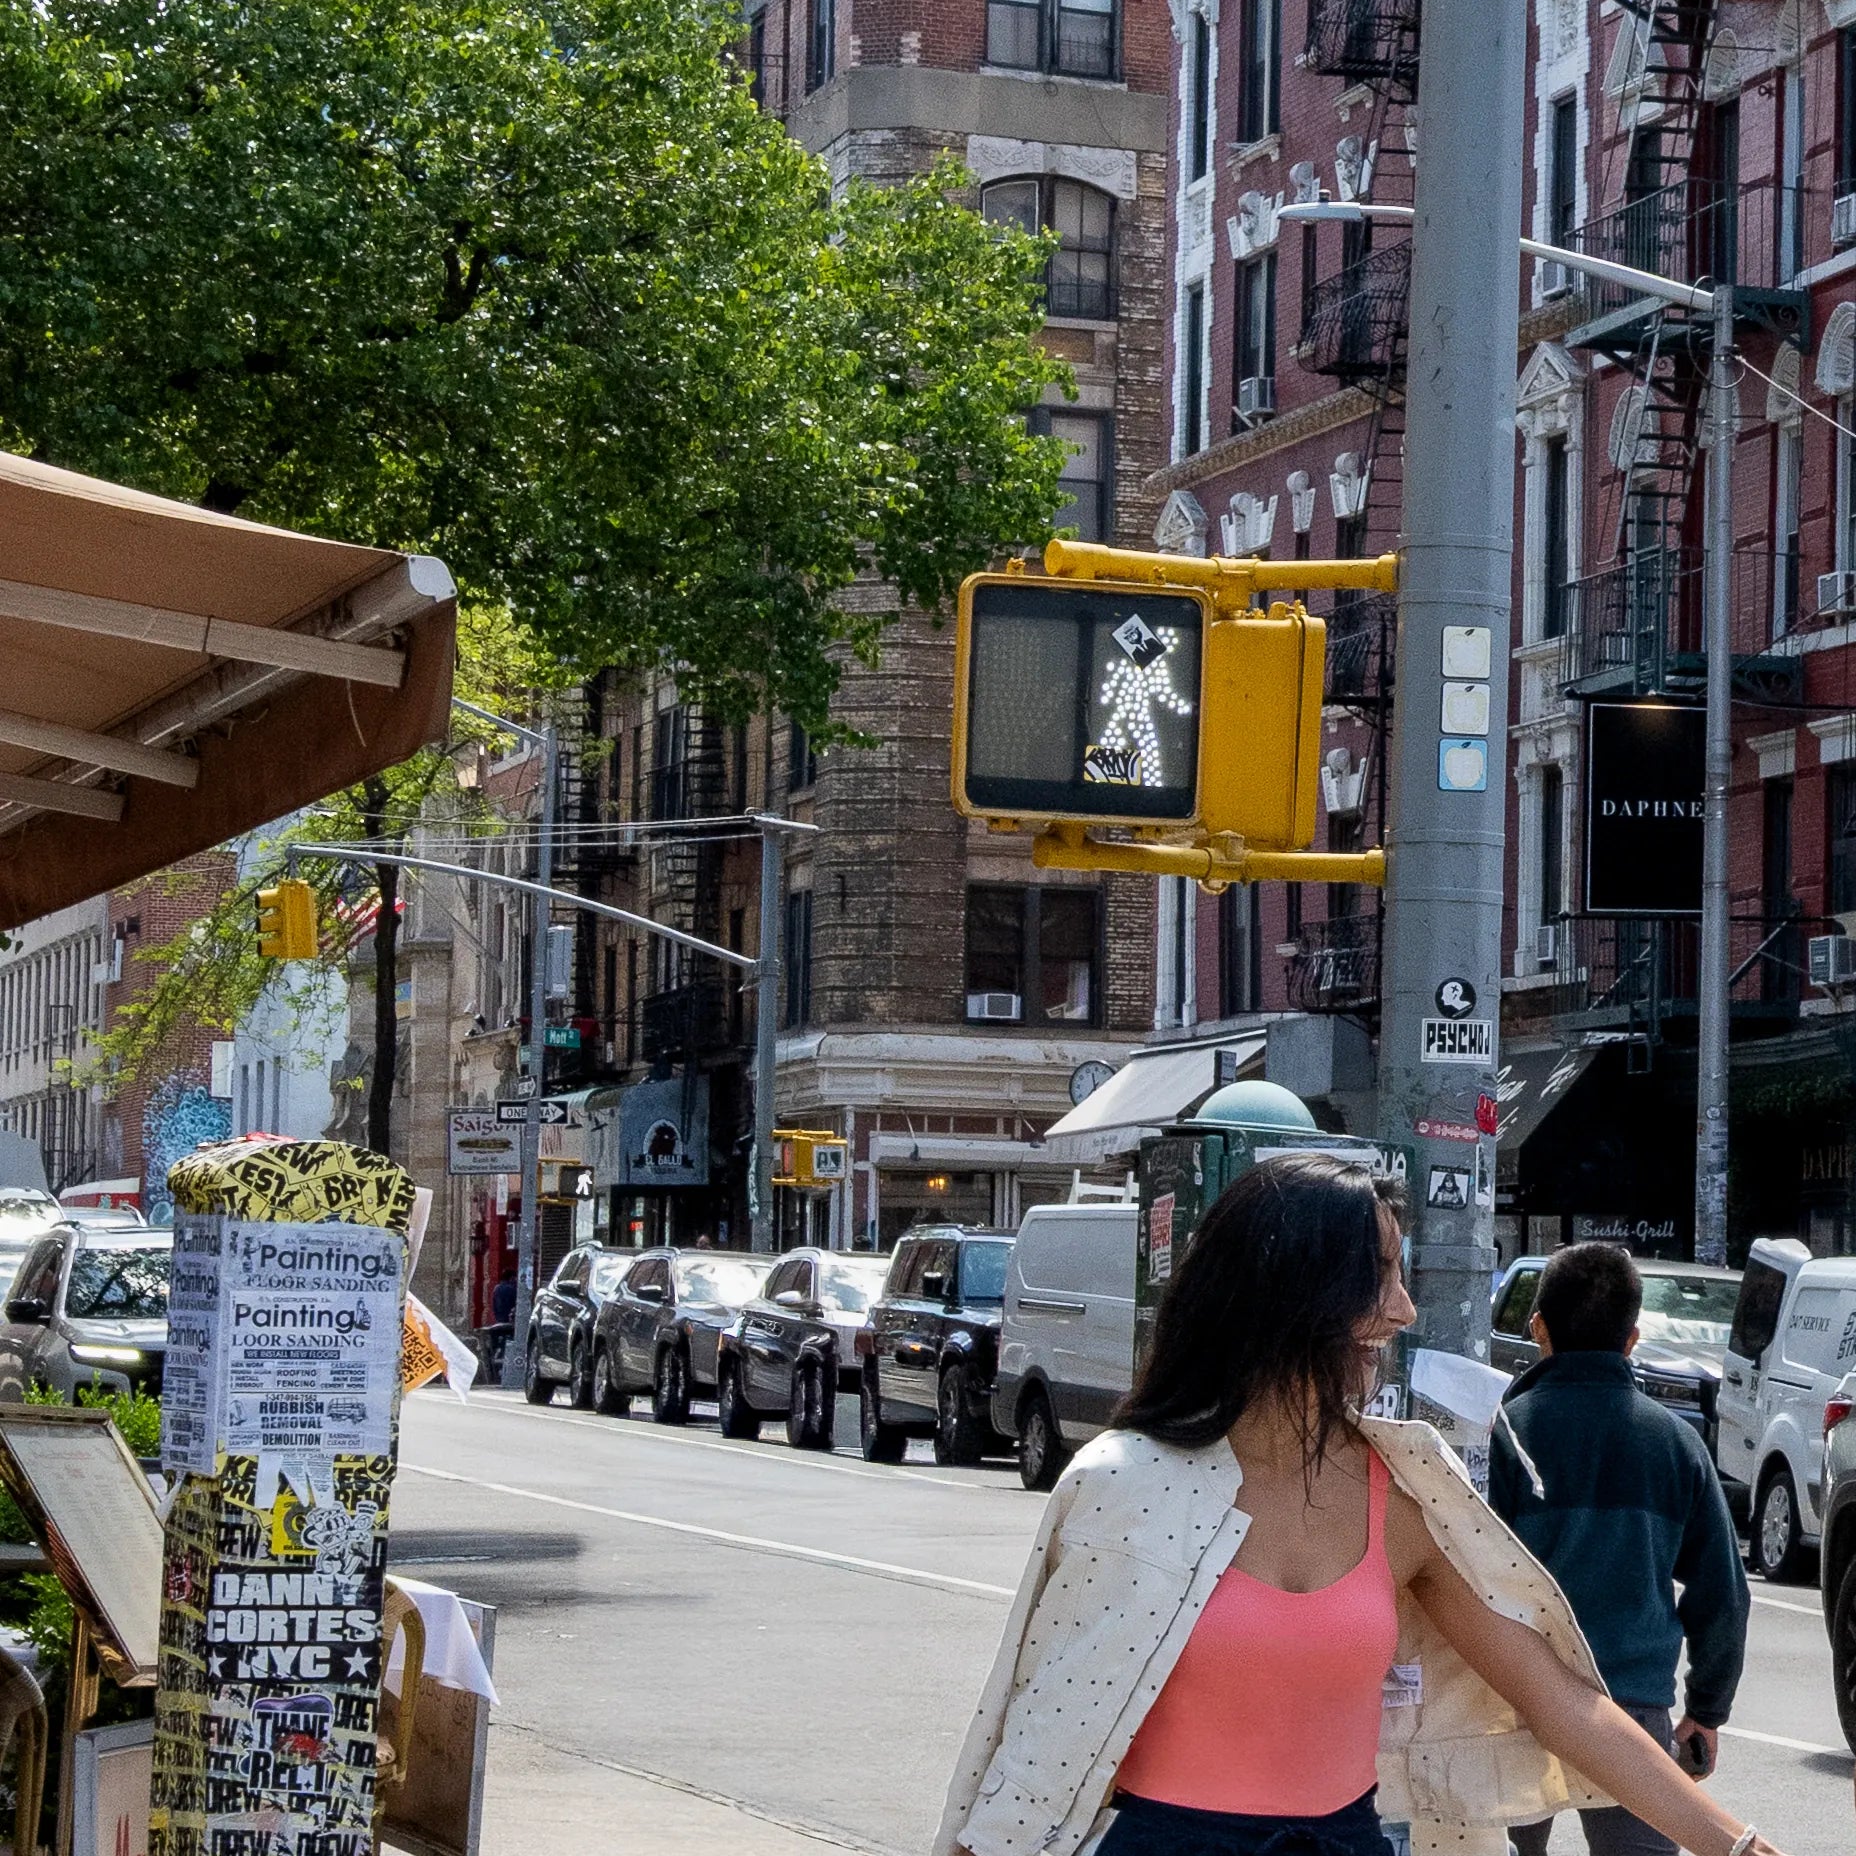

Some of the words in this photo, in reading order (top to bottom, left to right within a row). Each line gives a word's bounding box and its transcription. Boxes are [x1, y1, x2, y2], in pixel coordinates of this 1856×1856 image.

[1602, 799, 1704, 818] DAPHNE
[506, 1107, 527, 1118] ONE
[260, 1244, 381, 1278] Painting
[313, 1276, 390, 1292] SANDING
[234, 1303, 355, 1334] Painting
[1804, 1317, 1831, 1333] SERVICE
[285, 1334, 366, 1348] SANDING
[276, 1369, 317, 1377] ROOFING
[276, 1380, 316, 1388] FENCING
[259, 1401, 325, 1415] RUBBISH
[260, 1416, 323, 1430] REMOVAL
[262, 1432, 321, 1446] DEMOLITION
[213, 1573, 367, 1606] DANNY
[206, 1610, 378, 1643] CORTES
[237, 1645, 331, 1680] NYC
